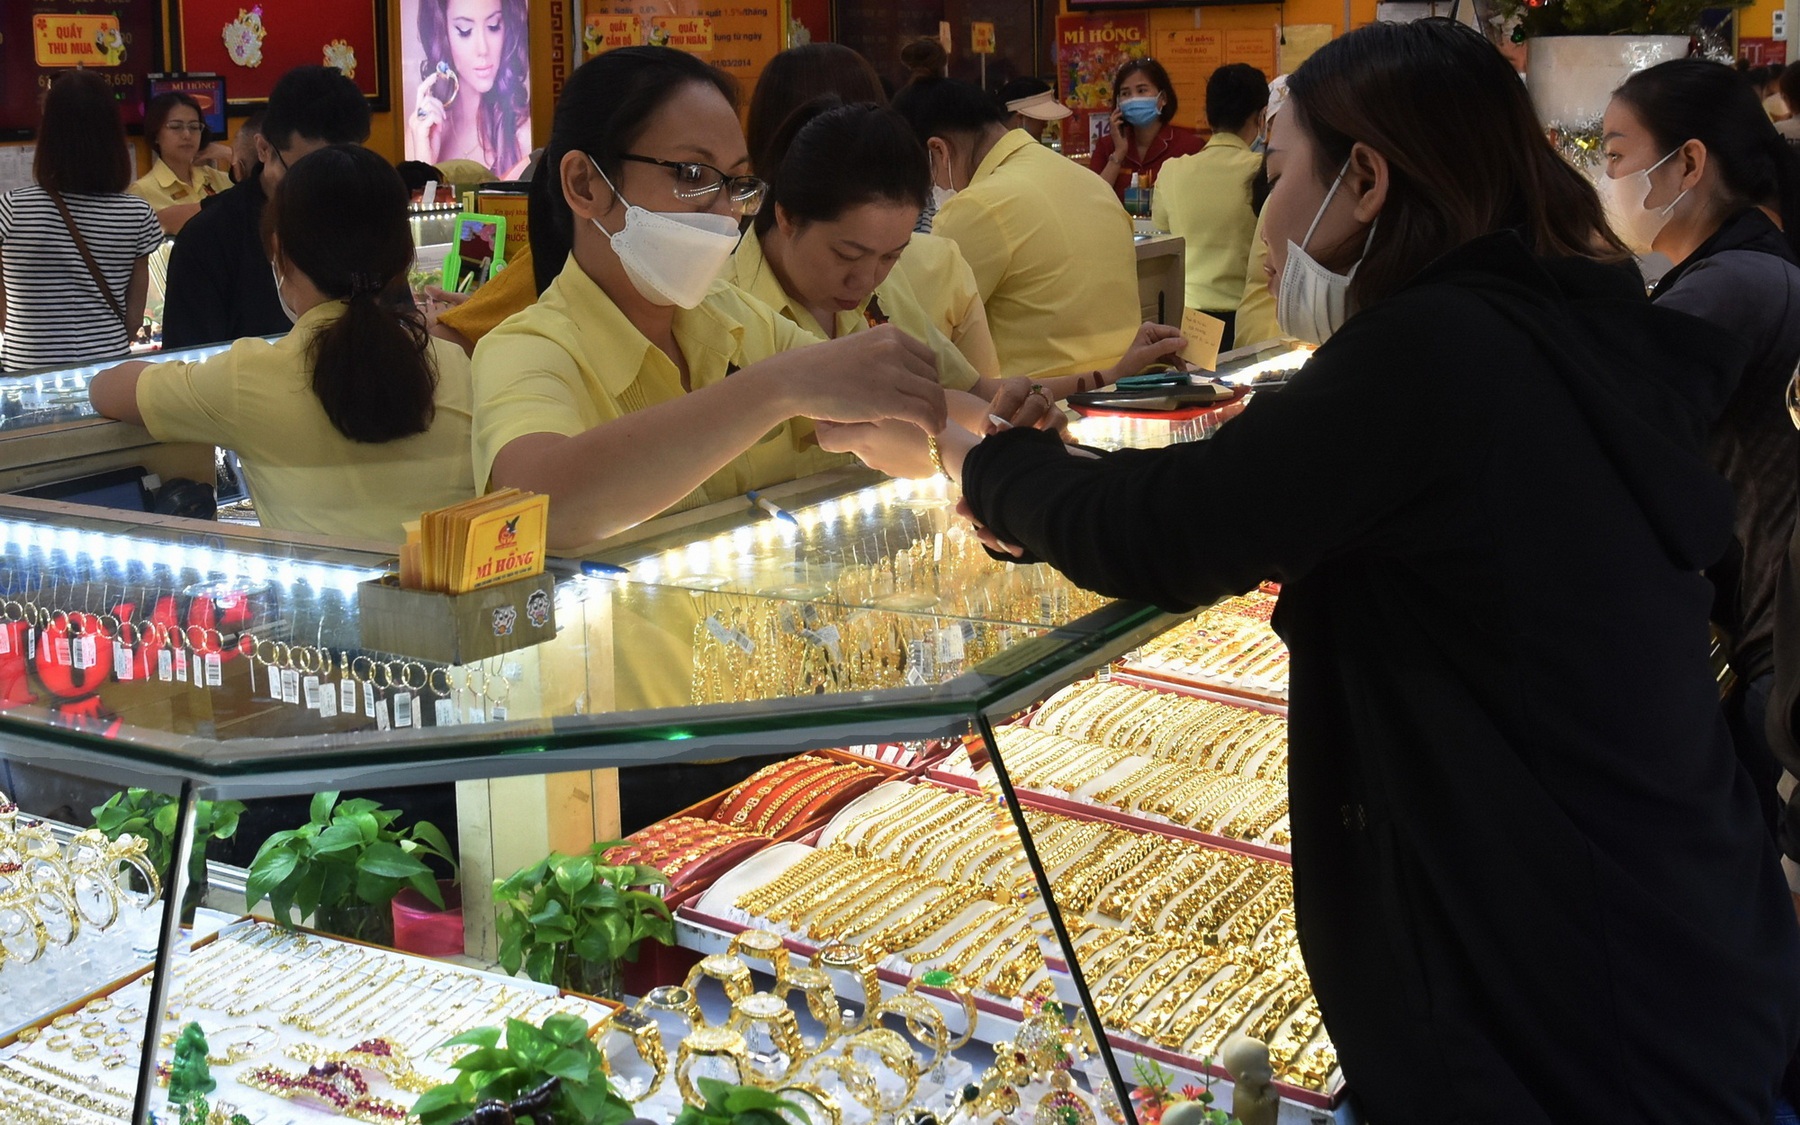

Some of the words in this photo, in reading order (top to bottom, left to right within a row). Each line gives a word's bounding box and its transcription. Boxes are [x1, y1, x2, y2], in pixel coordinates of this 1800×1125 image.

[670, 35, 684, 45] THU
[743, 33, 762, 42] ngày
[48, 42, 68, 55] THU
[70, 42, 93, 55] MUA
